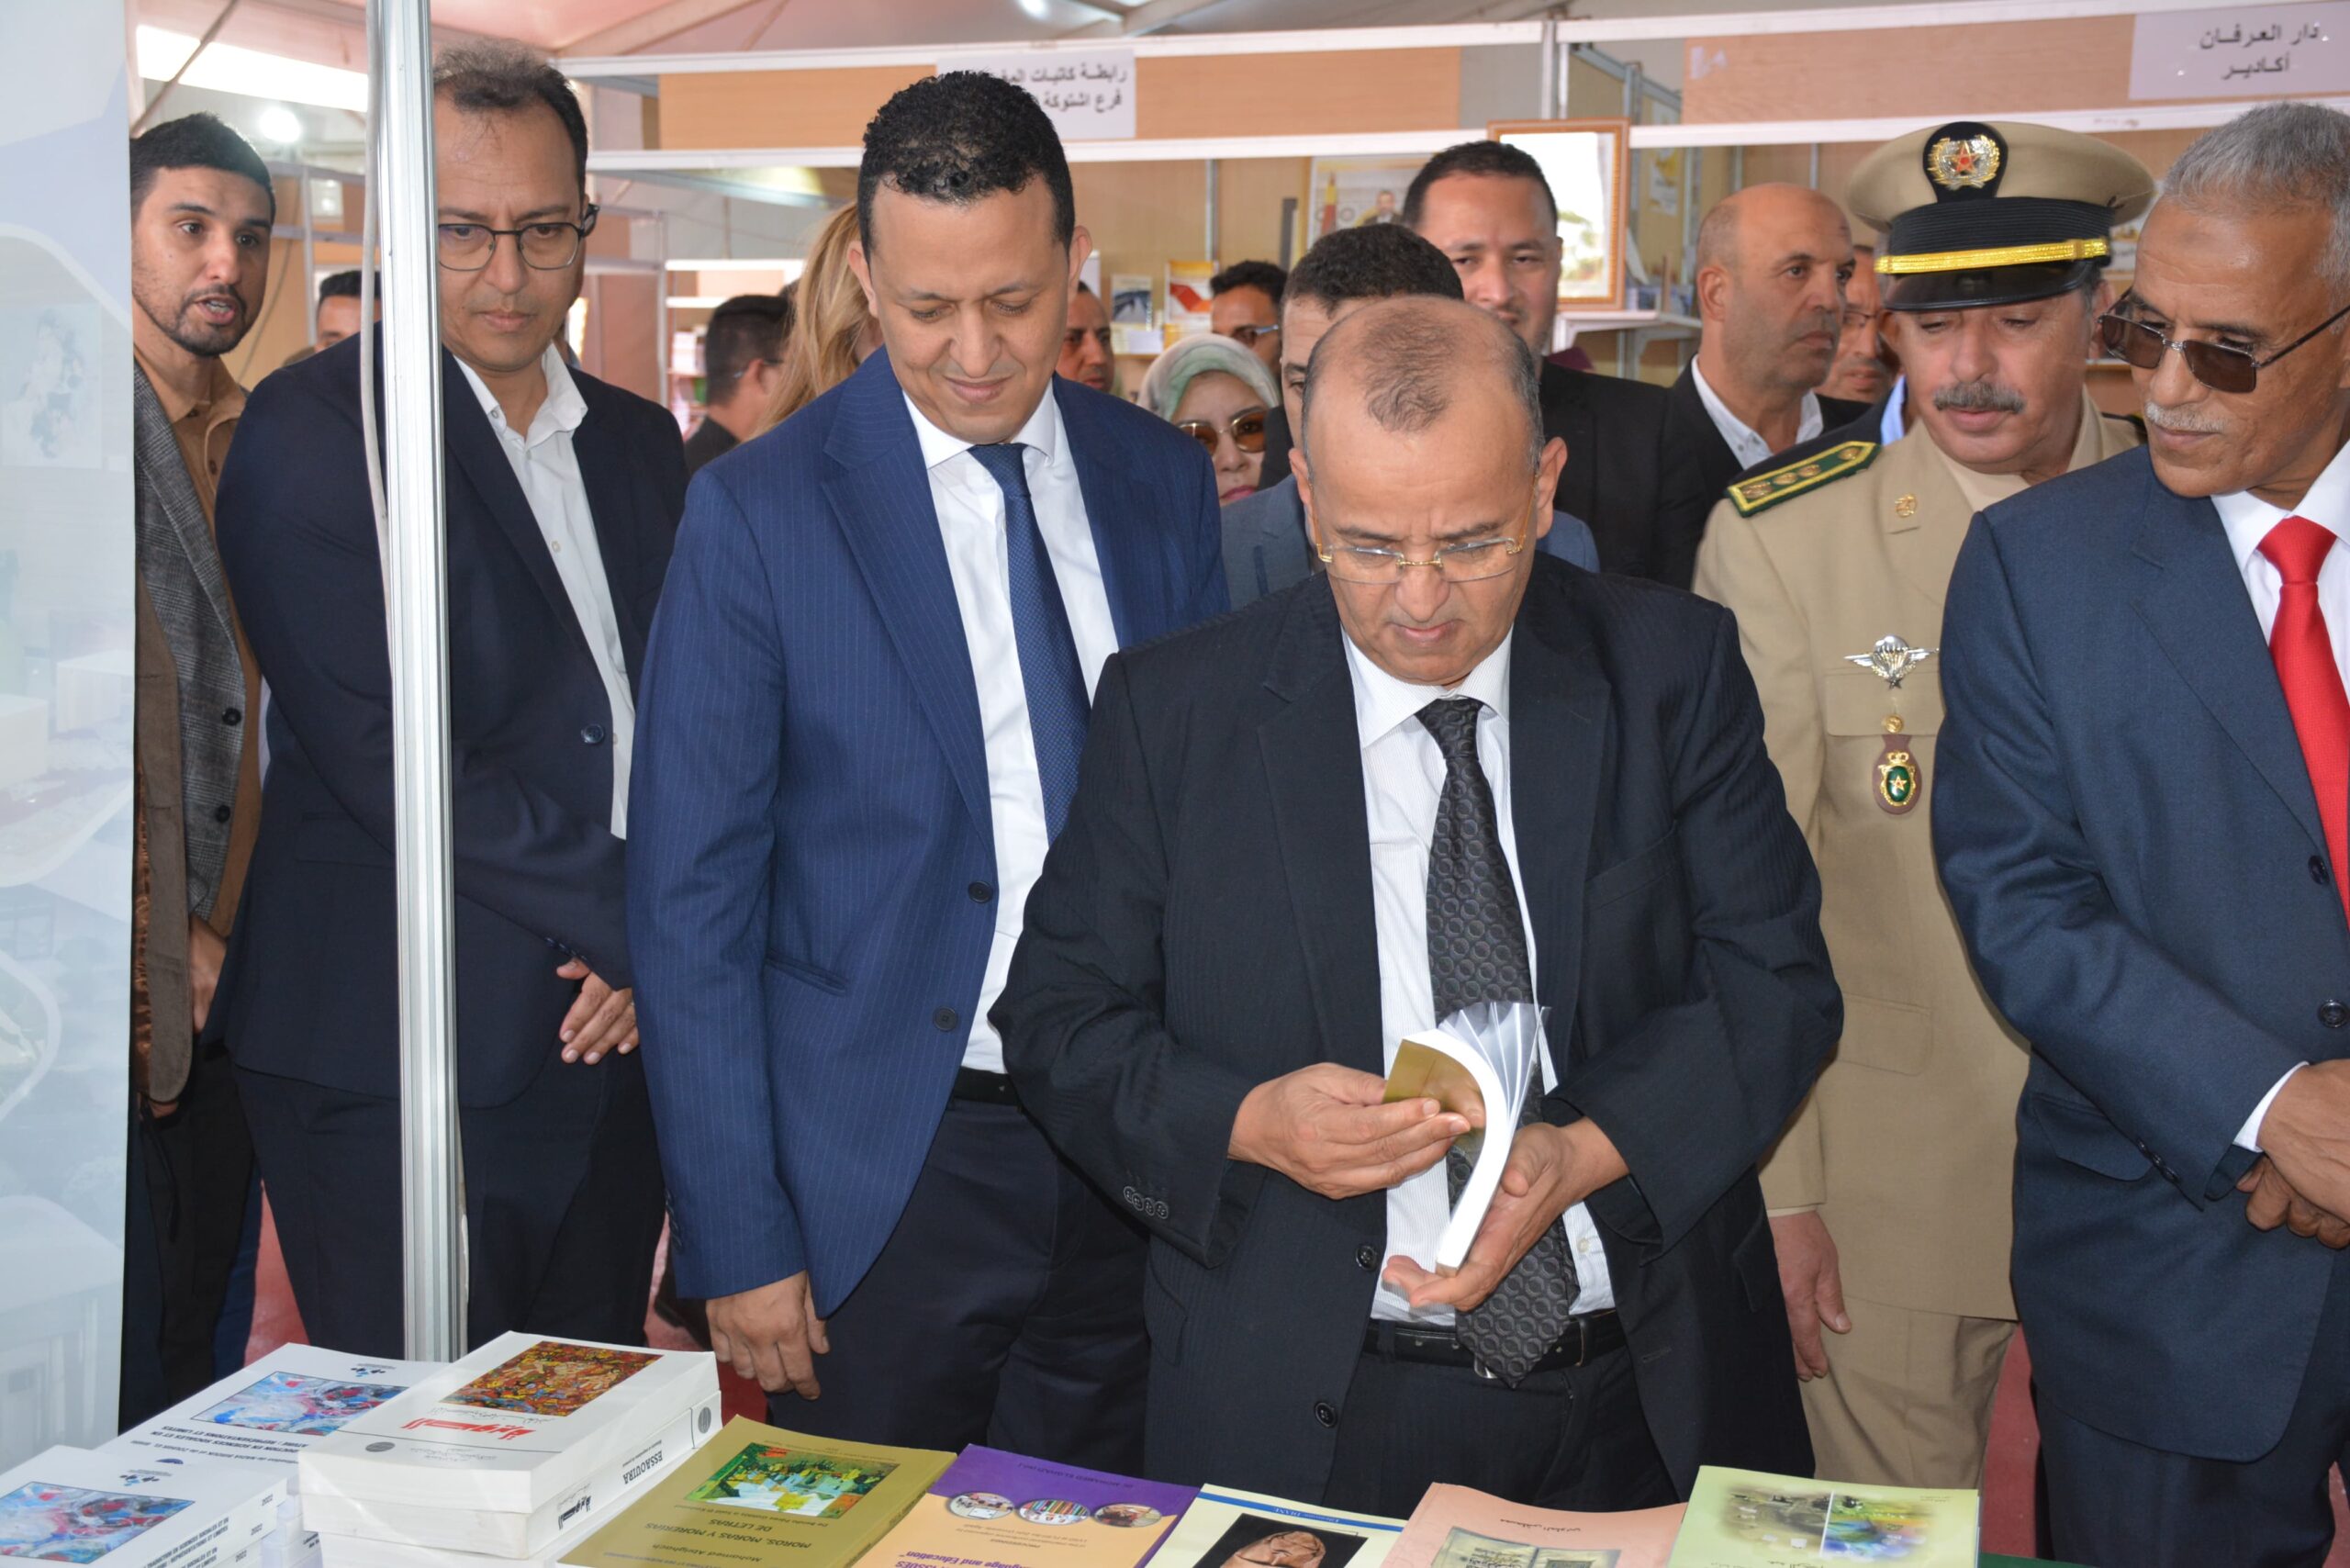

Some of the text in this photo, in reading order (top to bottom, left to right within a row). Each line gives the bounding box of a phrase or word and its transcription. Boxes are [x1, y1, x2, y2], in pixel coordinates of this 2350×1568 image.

[2200, 23, 2319, 49] دار العرفان
[1031, 67, 1076, 84] كاتبات
[1080, 62, 1127, 84] رابطة
[2221, 52, 2290, 80] أكادير
[1094, 89, 1122, 113] فرع
[622, 1450, 663, 1484] ESSAOUIRA
[708, 1518, 773, 1533] DE LETRAS
[1500, 1518, 1542, 1529] مصطفى
[719, 1531, 762, 1544] MORAS
[705, 1551, 762, 1562] Mohamed
